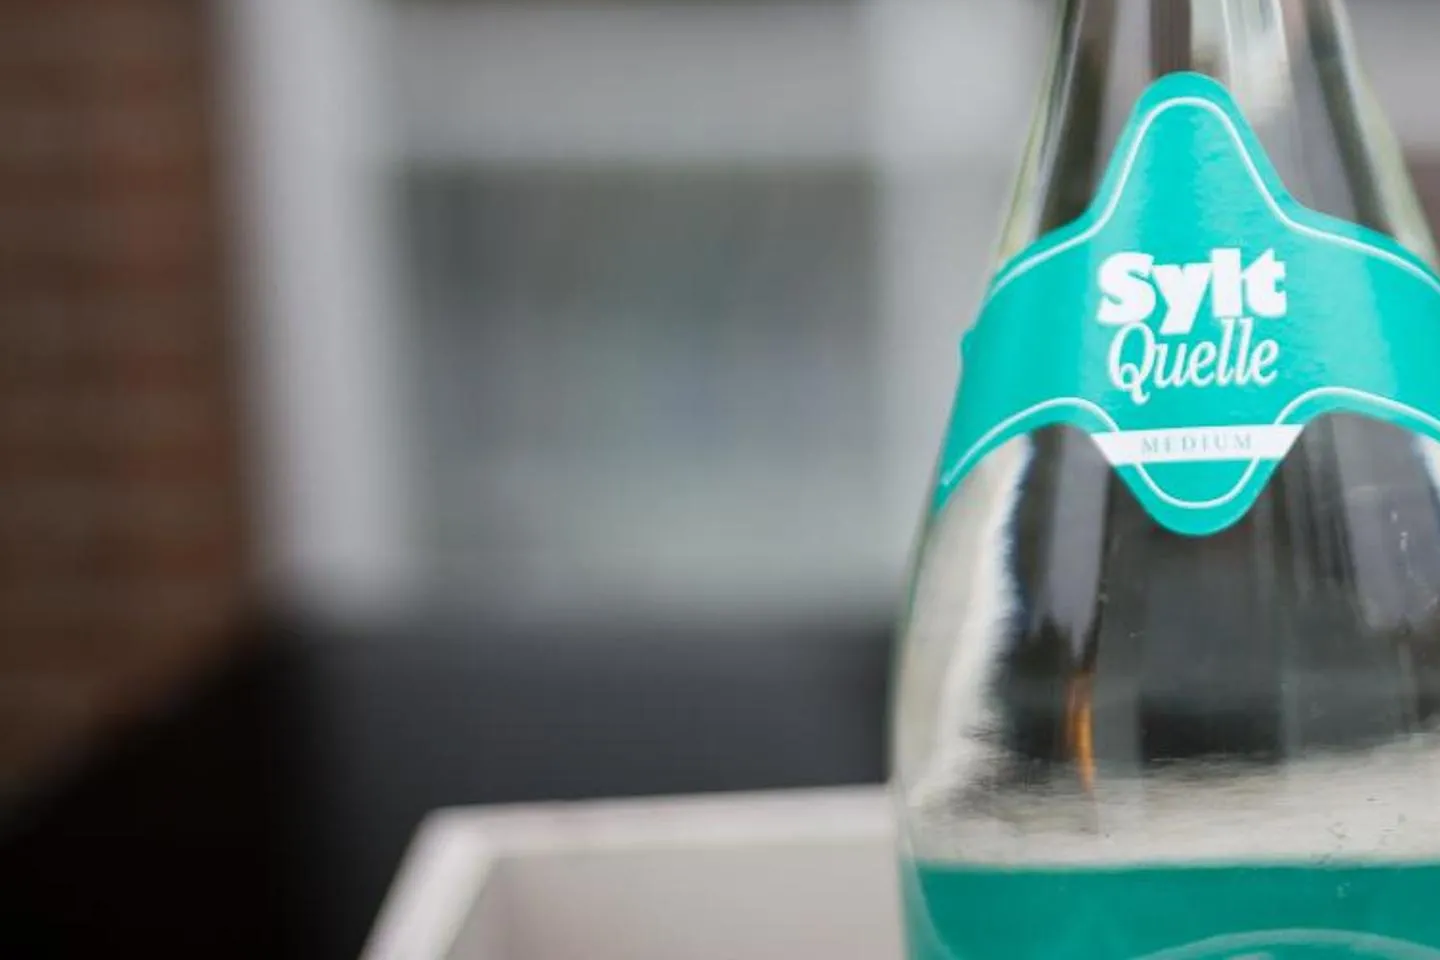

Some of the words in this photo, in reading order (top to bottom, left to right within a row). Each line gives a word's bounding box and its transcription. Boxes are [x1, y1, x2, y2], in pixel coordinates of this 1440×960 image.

[1097, 247, 1287, 334] Sylt
[1108, 318, 1280, 405] Quelle
[1141, 433, 1252, 453] MEDIUM
